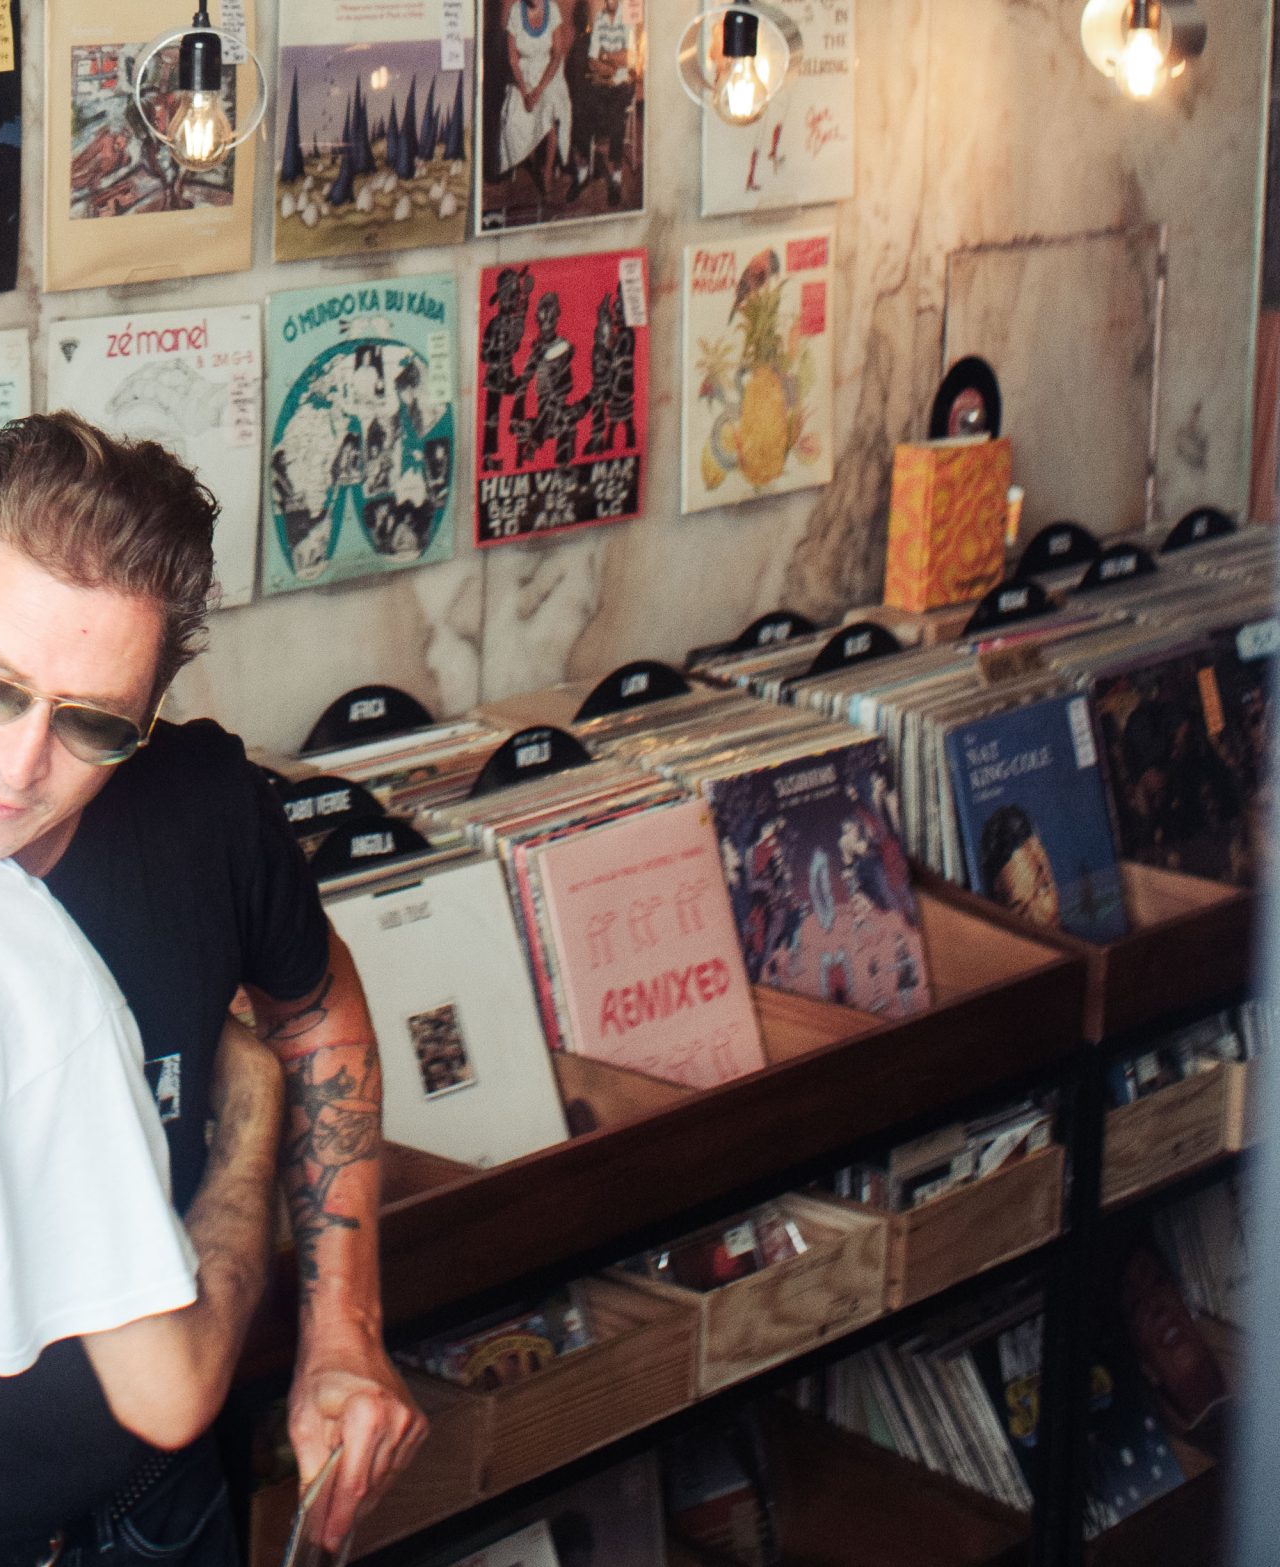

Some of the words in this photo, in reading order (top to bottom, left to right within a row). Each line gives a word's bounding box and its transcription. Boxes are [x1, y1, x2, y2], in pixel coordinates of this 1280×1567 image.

[283, 316, 297, 342] Ó
[298, 293, 356, 334] MUNDO
[359, 289, 380, 312] KA
[385, 289, 404, 312] BU
[106, 322, 133, 358] zé
[136, 318, 209, 355] manel
[481, 474, 530, 503] HUM
[350, 831, 395, 858] ANGOLA
[599, 957, 731, 1038] REMIXED
